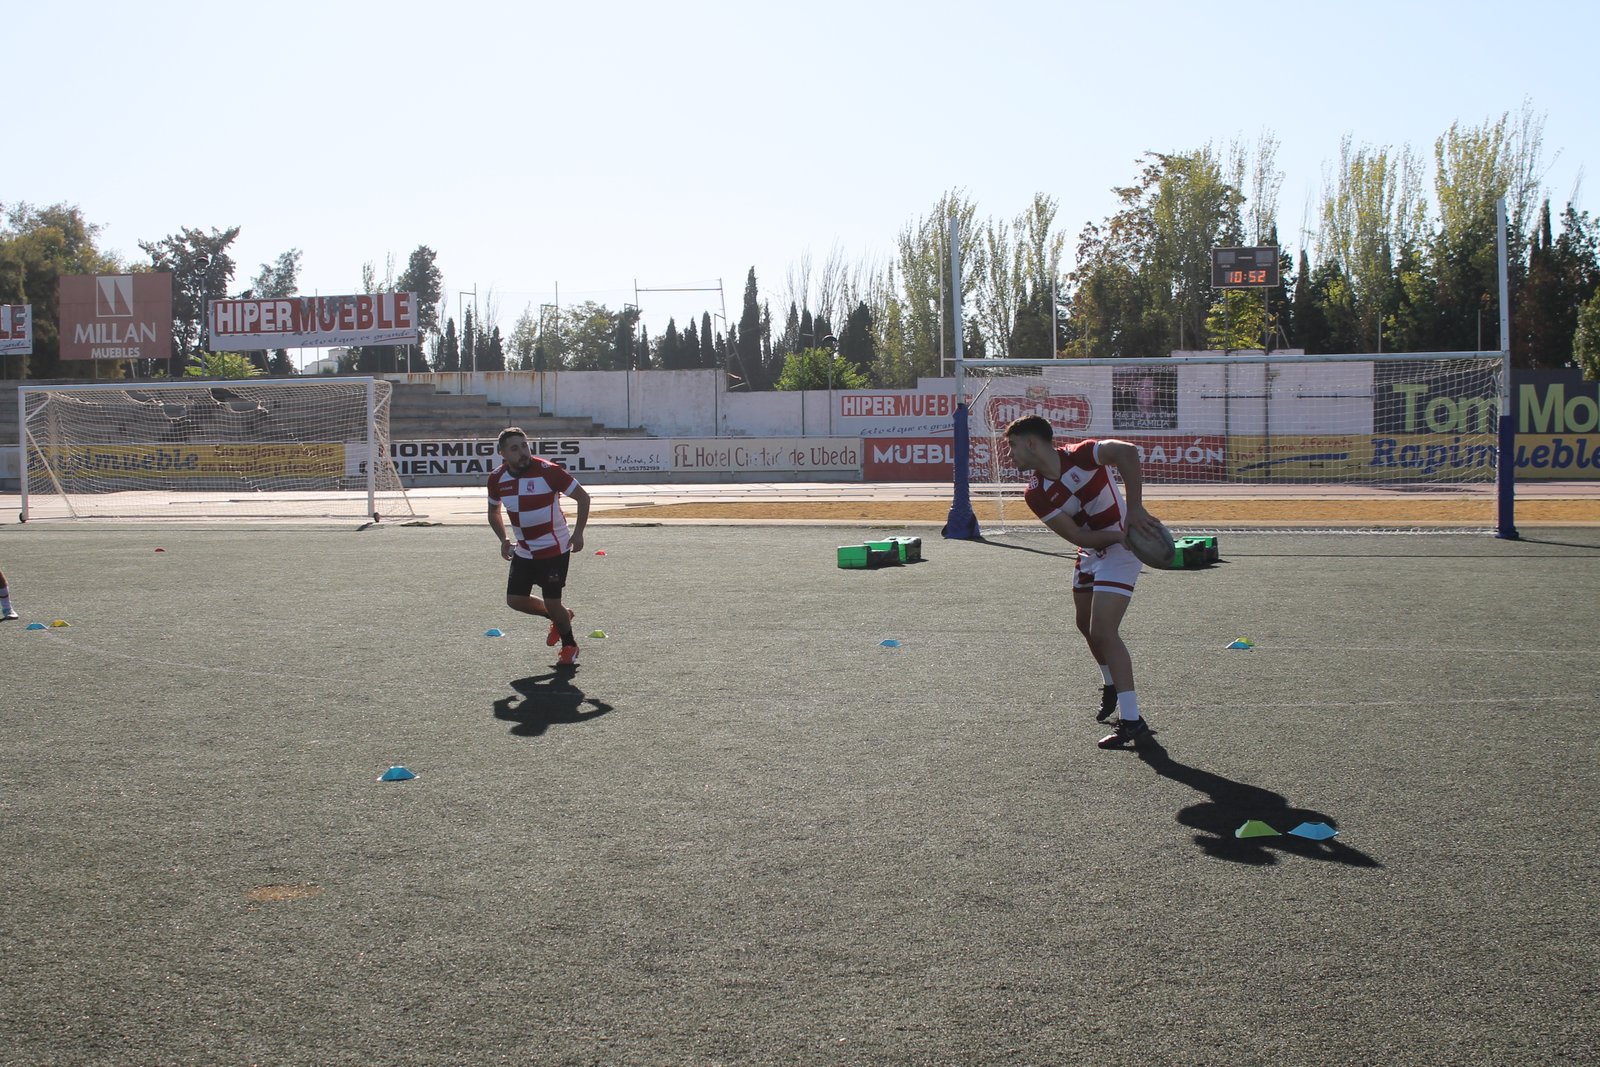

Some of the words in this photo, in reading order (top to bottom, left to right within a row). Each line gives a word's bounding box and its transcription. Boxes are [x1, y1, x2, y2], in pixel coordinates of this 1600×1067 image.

[1229, 270, 1266, 283] 10:52
[74, 322, 157, 344] MILLAN
[90, 347, 141, 359] MUEBLES
[1519, 384, 1600, 433] Mo
[696, 447, 730, 467] Hotel
[811, 446, 857, 466] Ubeda
[873, 444, 991, 464] MUEBLS
